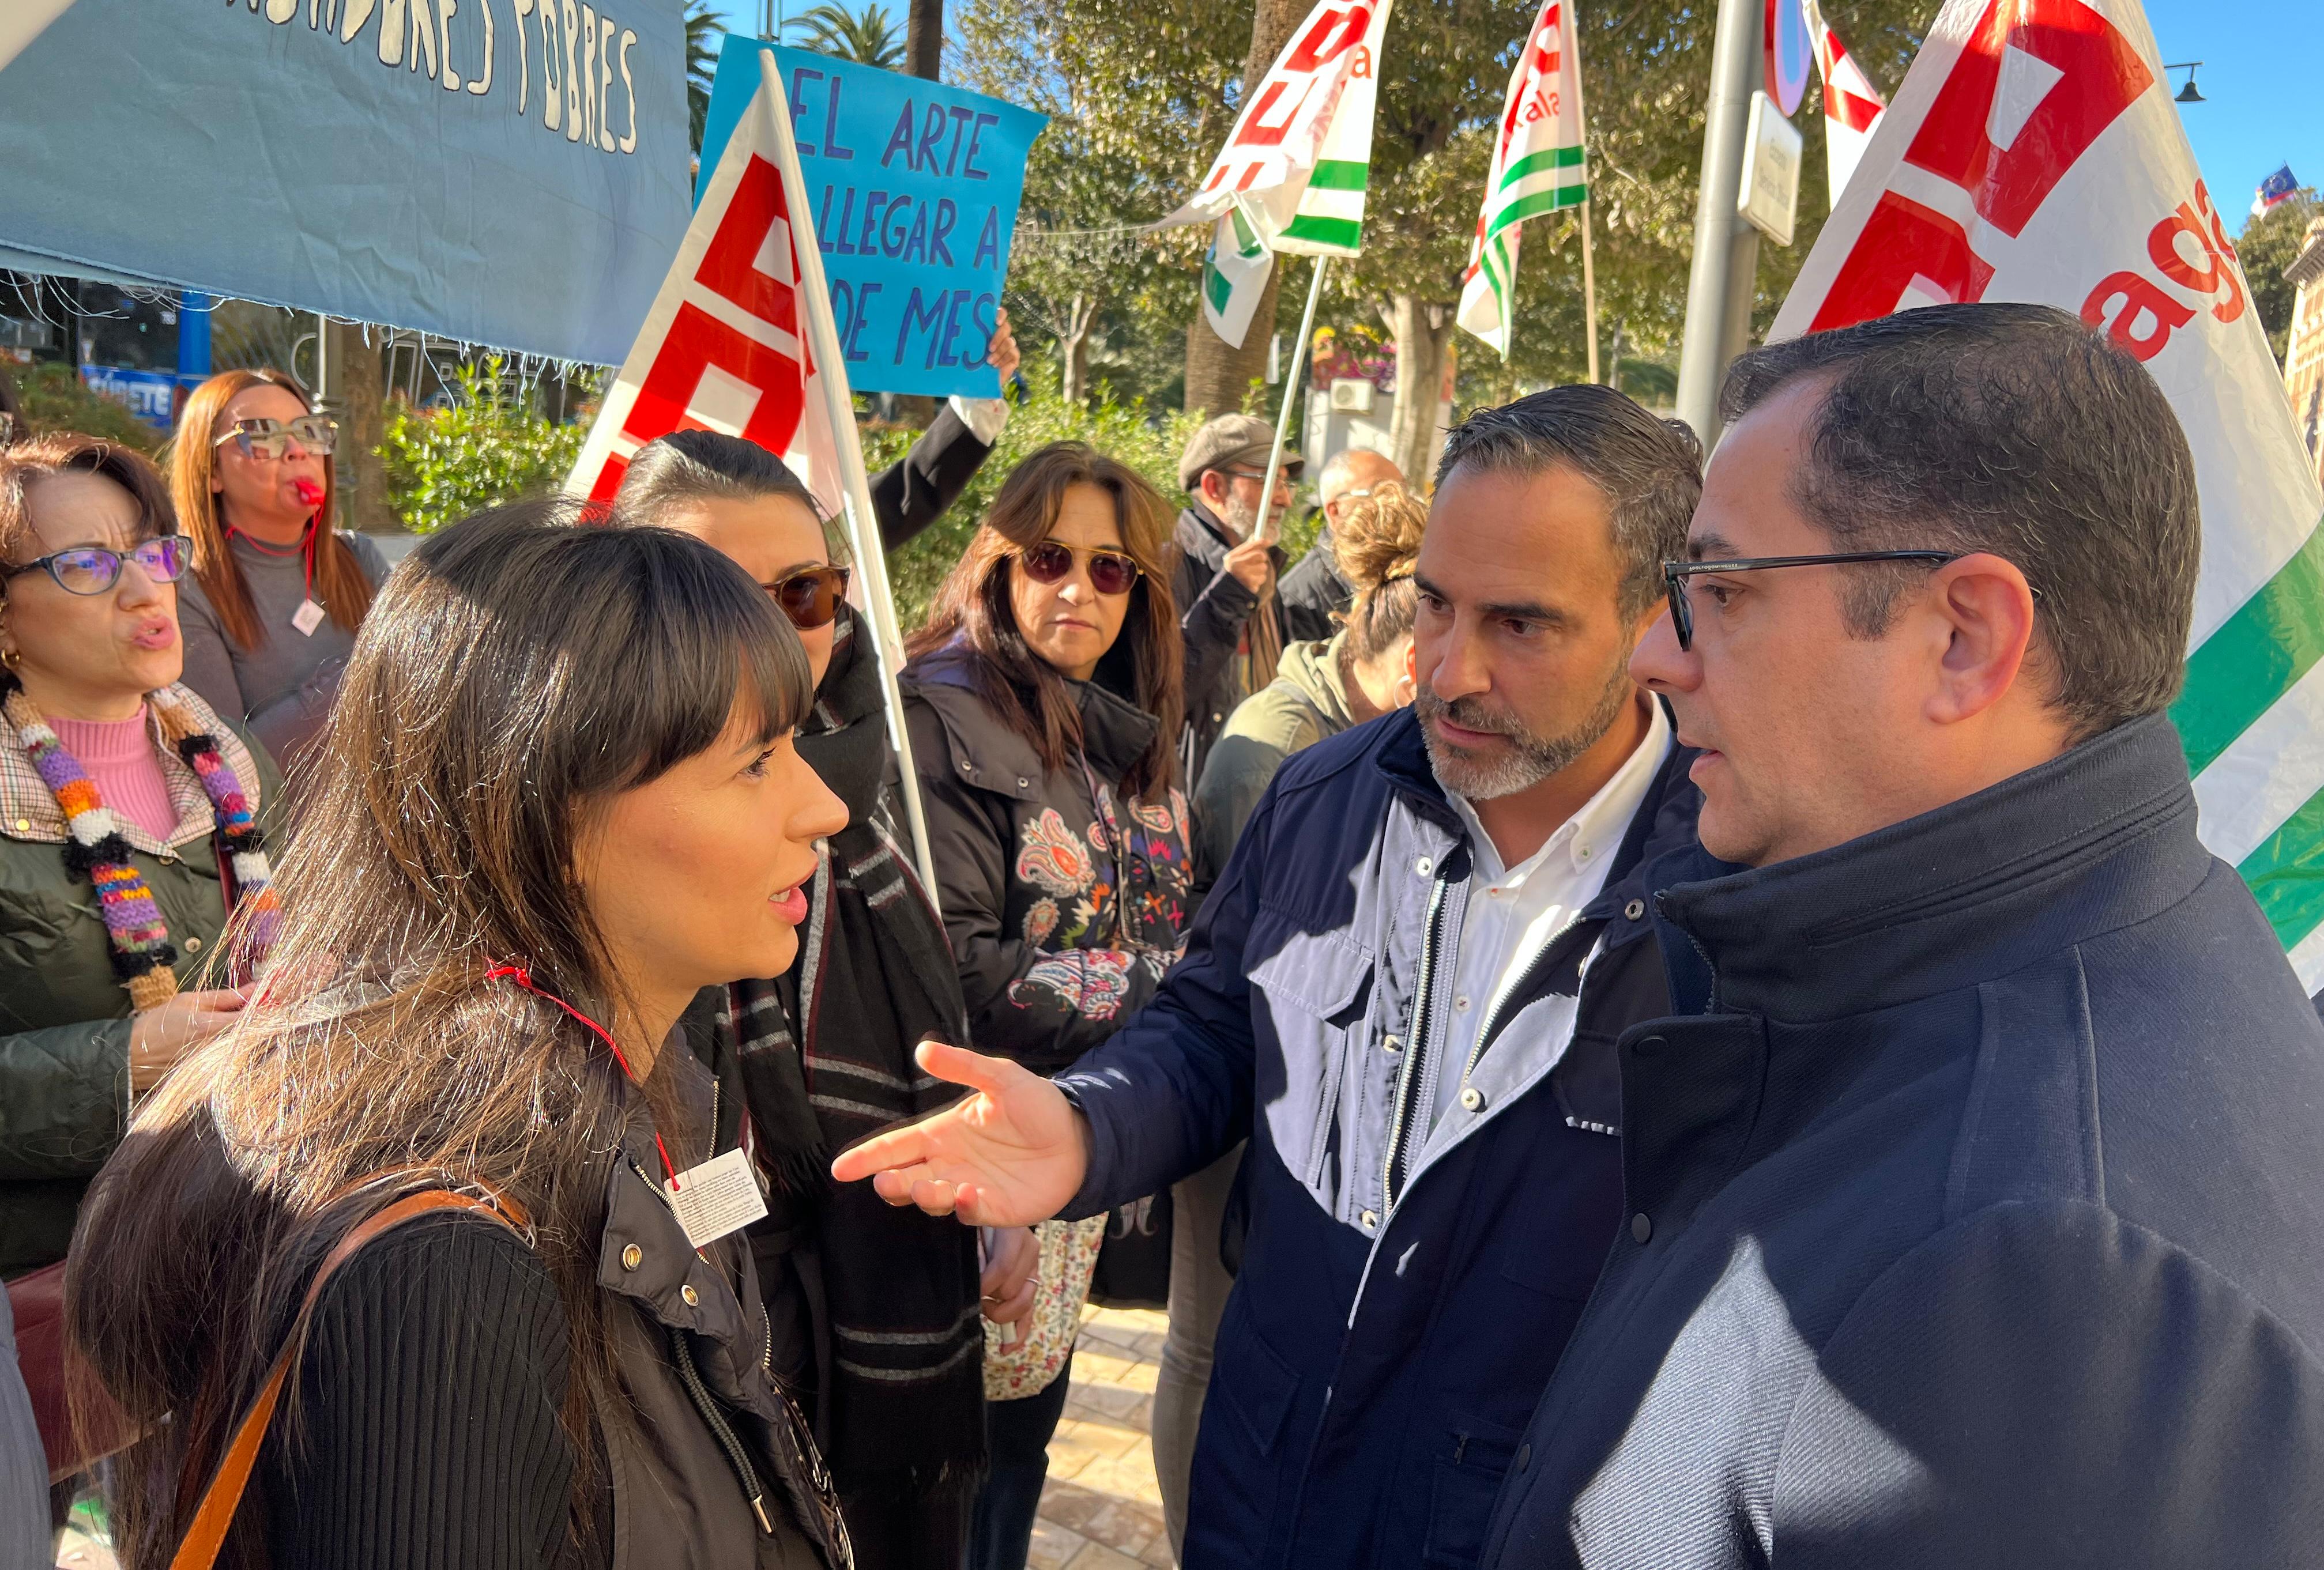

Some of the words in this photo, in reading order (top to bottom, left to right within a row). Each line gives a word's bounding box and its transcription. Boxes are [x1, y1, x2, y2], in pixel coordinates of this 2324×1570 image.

[513, 0, 638, 154] POBRES
[790, 68, 854, 160] EL
[880, 98, 1000, 180] ARTE
[818, 185, 957, 268] LLEGAR
[973, 205, 999, 271] A
[829, 278, 883, 362] DE
[894, 287, 996, 372] MES
